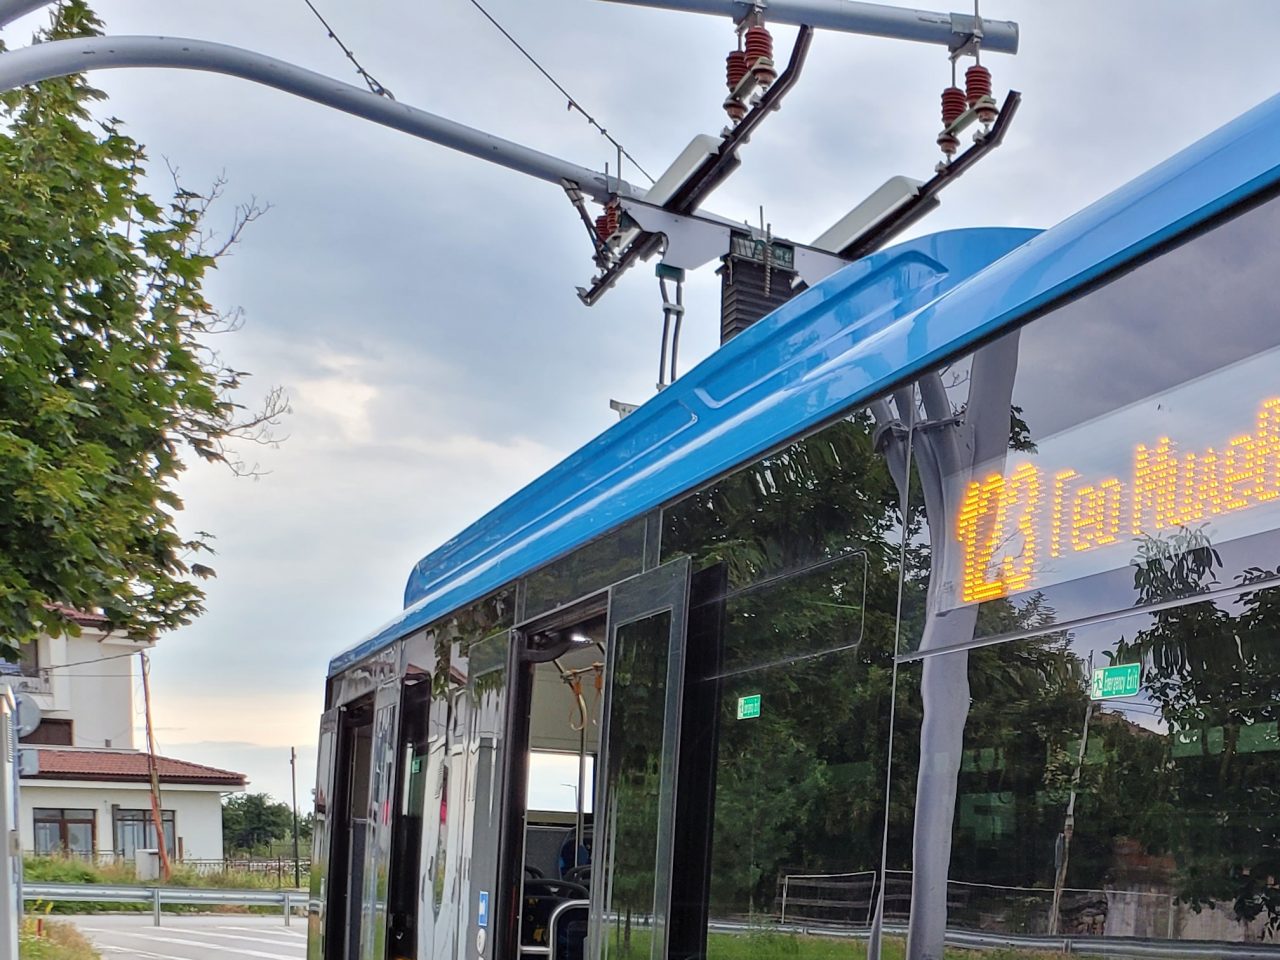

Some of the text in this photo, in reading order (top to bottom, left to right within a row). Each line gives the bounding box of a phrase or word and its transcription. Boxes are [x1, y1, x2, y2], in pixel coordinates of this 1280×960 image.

[1050, 469, 1121, 557] Гео
[1104, 668, 1138, 694] Emergency Exit
